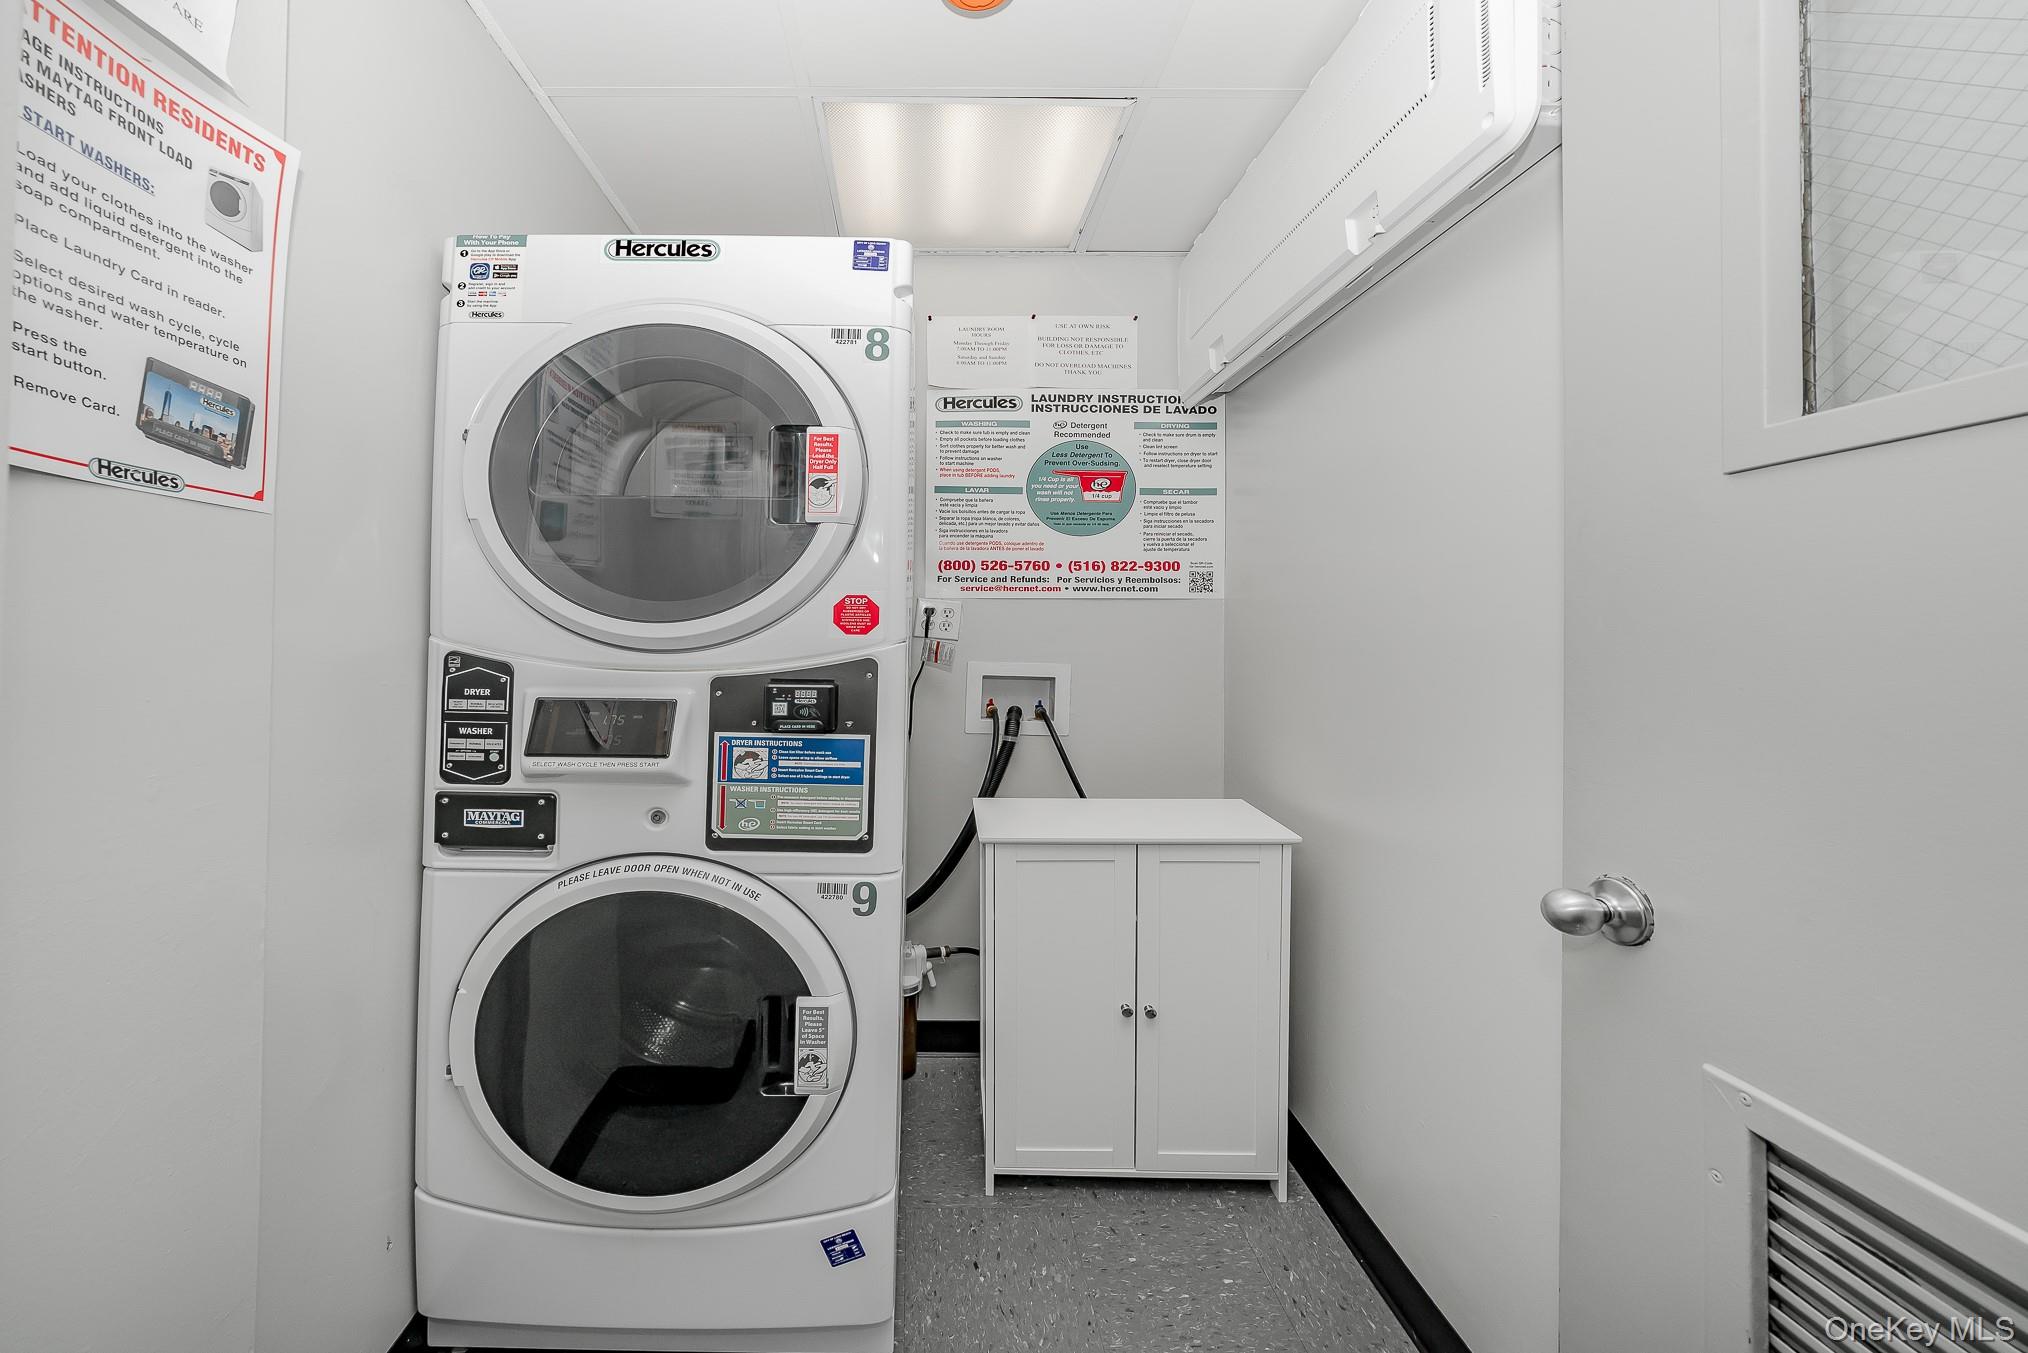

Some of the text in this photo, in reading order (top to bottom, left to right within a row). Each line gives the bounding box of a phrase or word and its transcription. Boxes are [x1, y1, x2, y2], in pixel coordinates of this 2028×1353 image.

[172, 1, 204, 33] ARE
[24, 0, 266, 172] TTENTION RESIDENTS
[58, 54, 164, 135] INSTRUCTIONS
[37, 60, 193, 170] MAYTAG FRONT LOAD
[22, 105, 155, 195] START WASHERS:
[16, 180, 160, 260] soap compartment.
[16, 161, 244, 284] and add liquid detergent into the
[17, 141, 254, 275] Load your clothes into the washer
[615, 240, 712, 257] Hercules
[15, 213, 226, 318] Place Laundry Card in reader.
[12, 286, 104, 330] the washer.
[14, 249, 240, 352] Select desired wash cycle, cycle
[13, 269, 248, 368] options and water temperature on
[12, 320, 87, 357] Press the
[865, 328, 890, 361] 8
[11, 341, 107, 381] start button.
[13, 375, 120, 417] Remove Card.
[202, 398, 235, 417] Hercules
[943, 396, 1017, 409] Hercules
[1031, 394, 1184, 404] LAUNDRY INSTRUCTIO
[1031, 404, 1217, 414] INSTRUCCIONES DE LAVADO
[1054, 431, 1111, 439] Recommended
[1070, 421, 1108, 430] Detergent
[97, 459, 179, 489] Hercules
[1072, 460, 1121, 468] Over-Sudsing.
[937, 560, 976, 573] (800)
[980, 560, 1051, 571] 526-5760
[1068, 560, 1106, 573] (516)
[1110, 560, 1181, 572] 822-9300
[1074, 576, 1115, 584] Servicios
[1125, 576, 1181, 584] Reembolsos:
[844, 597, 868, 605] STOP
[464, 688, 491, 696] DRYER
[458, 727, 493, 735] WASHER
[729, 785, 809, 794] WASHER INSTRUCTIONS
[467, 811, 521, 821] MAYTAG
[557, 864, 762, 902] PLEASE LEAVE DOOR OPEN WHEN NOT IN USE
[852, 881, 878, 917] 9
